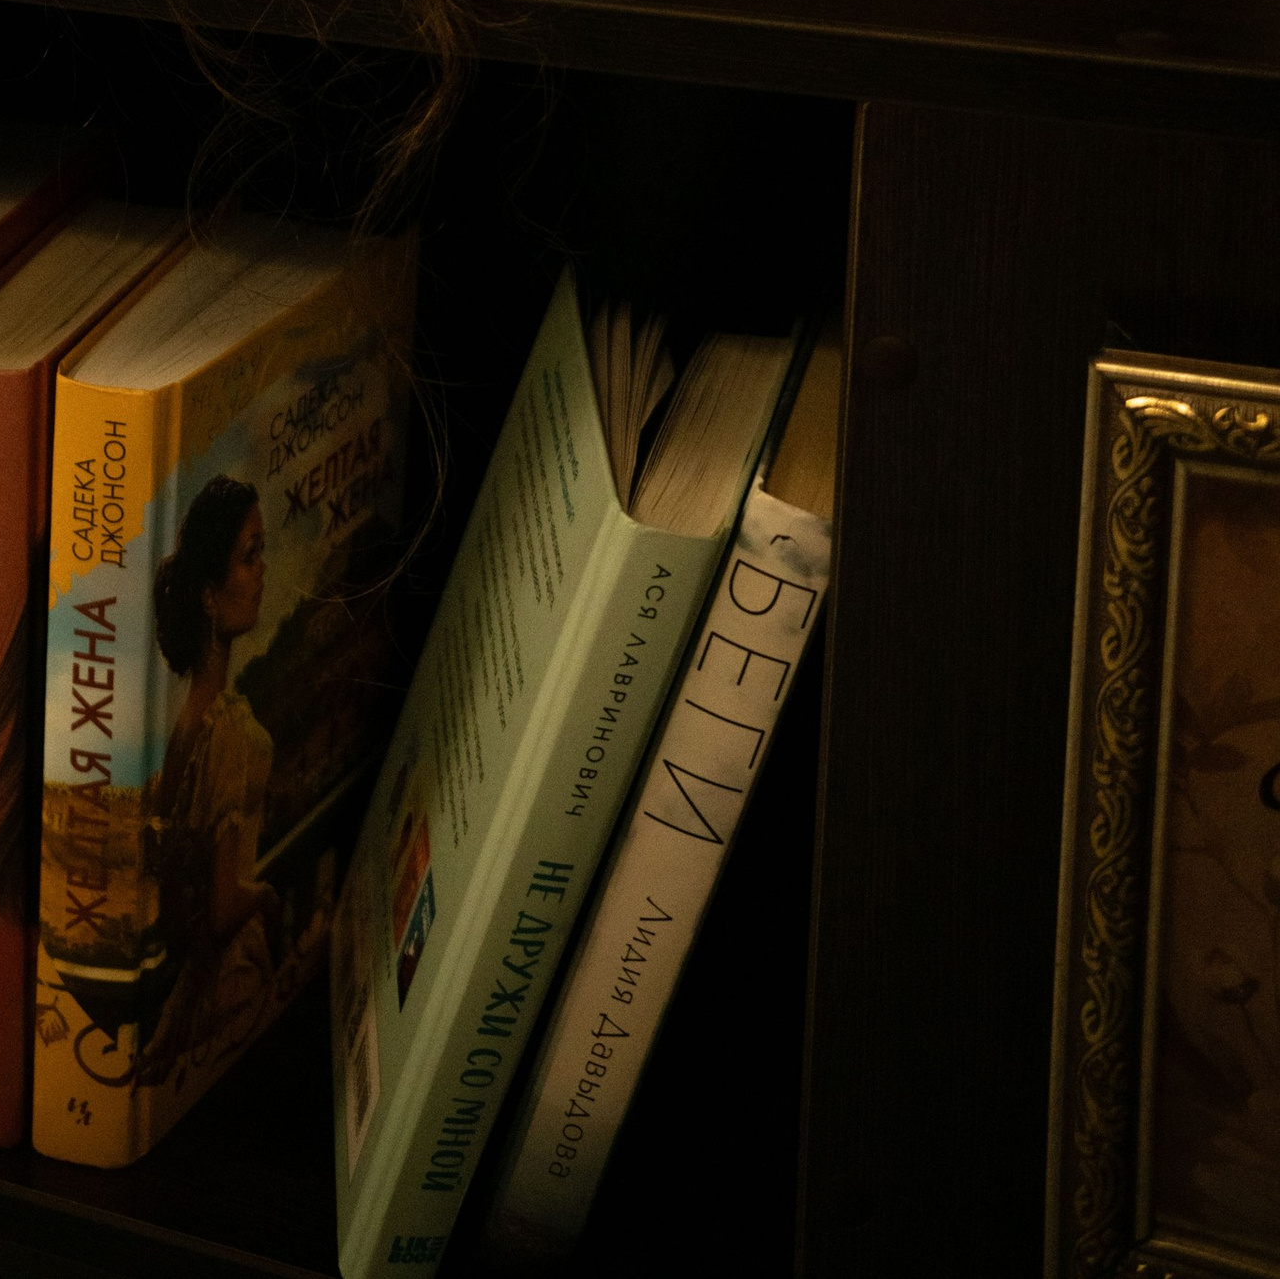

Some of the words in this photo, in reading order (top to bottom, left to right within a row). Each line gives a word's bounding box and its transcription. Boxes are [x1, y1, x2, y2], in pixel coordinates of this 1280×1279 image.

[265, 381, 366, 482] ДЖОНСОН
[71, 458, 97, 562] САДЕКА
[100, 419, 127, 569] ДЖОНСОН
[637, 563, 672, 620] АСЯ
[70, 595, 118, 740] ЖЕНА
[643, 558, 818, 845] БЕГИ
[564, 632, 647, 817] ЛАВРИНОВИЧ
[526, 859, 575, 905] НЕ
[476, 909, 555, 1038] ДРУЖИ
[611, 895, 674, 1005] Лидия
[459, 1047, 503, 1090] СО
[547, 1011, 631, 1180] Давыдова
[420, 1097, 488, 1193] МНОЙ
